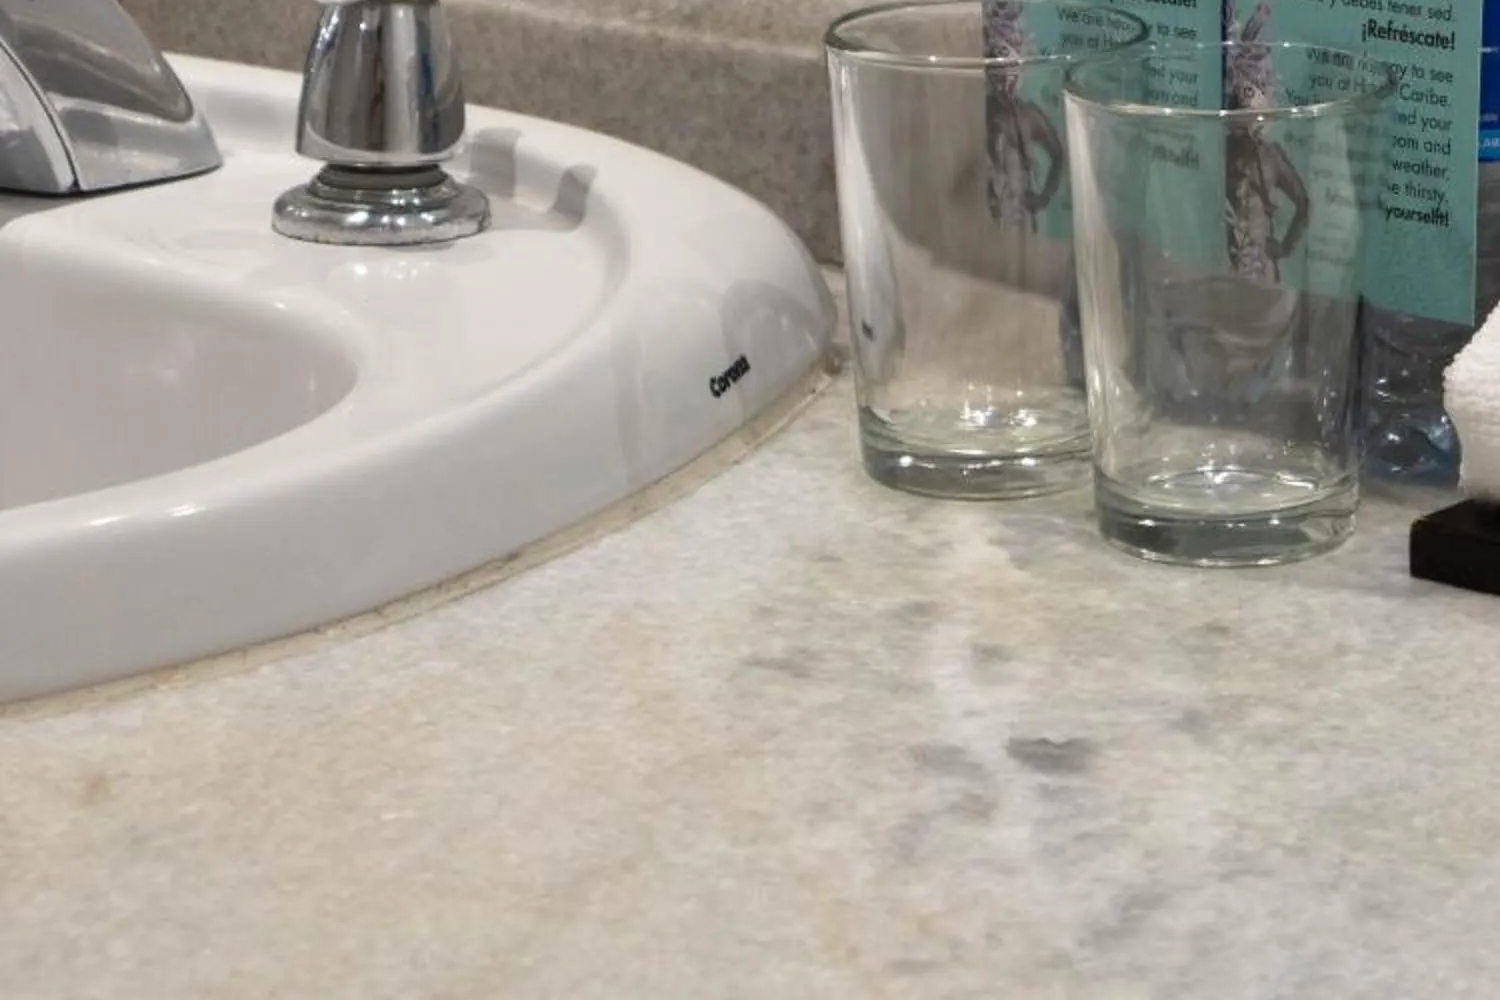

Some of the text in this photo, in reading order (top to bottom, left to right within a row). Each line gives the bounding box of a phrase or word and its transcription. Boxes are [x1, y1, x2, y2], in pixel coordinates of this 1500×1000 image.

[1362, 17, 1456, 50] ¡Refréscate!
[1411, 63, 1426, 80] to
[1429, 68, 1454, 84] see
[1399, 83, 1452, 108] Caribe.
[1421, 117, 1453, 133] your
[1423, 137, 1452, 156] and
[709, 354, 751, 398] Corona
